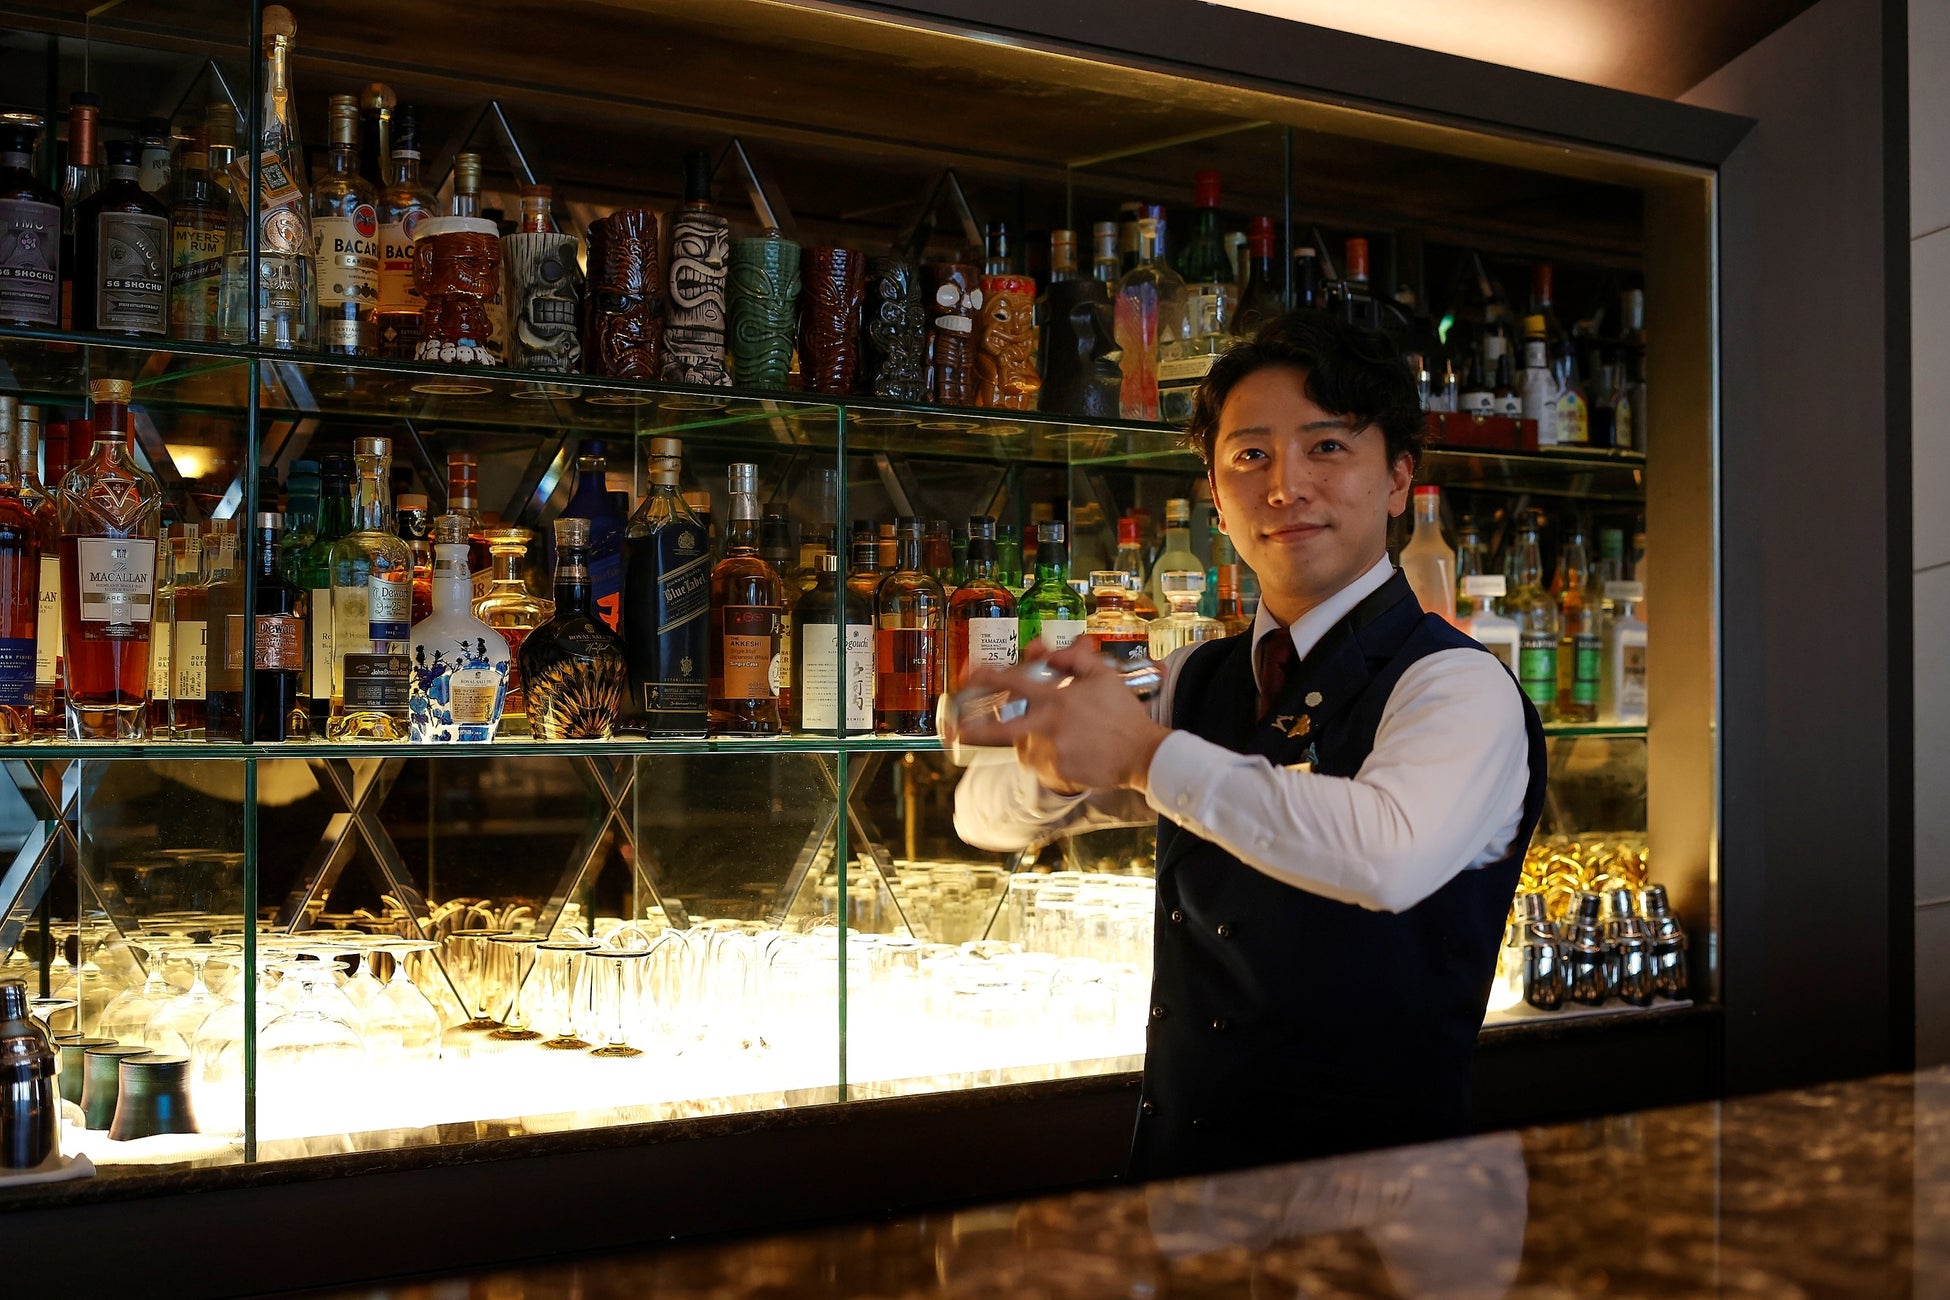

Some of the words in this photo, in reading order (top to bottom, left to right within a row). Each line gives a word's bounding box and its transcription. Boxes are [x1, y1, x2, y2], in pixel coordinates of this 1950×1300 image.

[191, 244, 216, 252] RUM
[15, 270, 54, 281] SHOCHU
[125, 281, 162, 291] SHOCHU
[22, 499, 33, 508] 15
[90, 572, 148, 583] MACALLAN
[473, 583, 485, 598] 18
[664, 585, 686, 603] Blue
[685, 573, 706, 594] Label
[988, 652, 999, 661] 25
